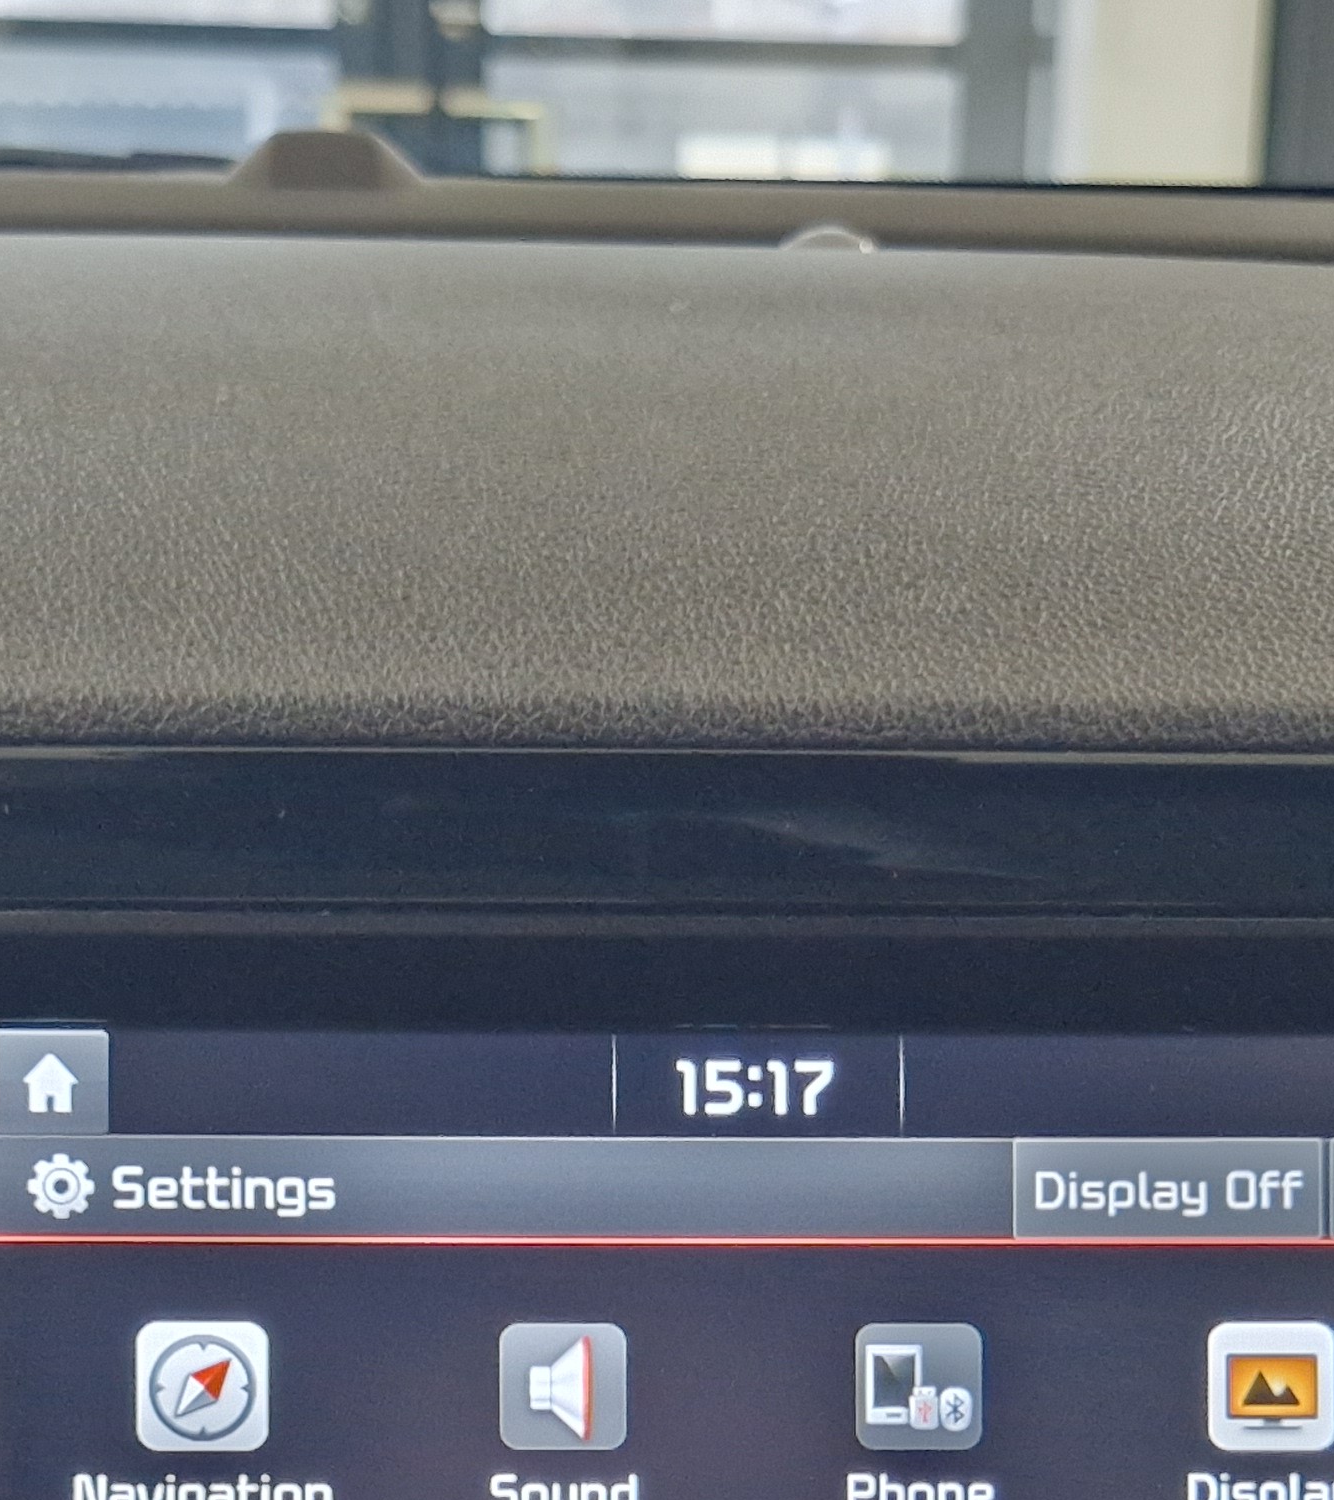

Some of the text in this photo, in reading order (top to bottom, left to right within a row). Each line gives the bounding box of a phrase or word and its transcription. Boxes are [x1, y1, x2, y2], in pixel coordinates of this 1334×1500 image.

[676, 1059, 834, 1115] 15:17
[112, 1166, 335, 1217] Settings
[1035, 1170, 1303, 1216] Display Off
